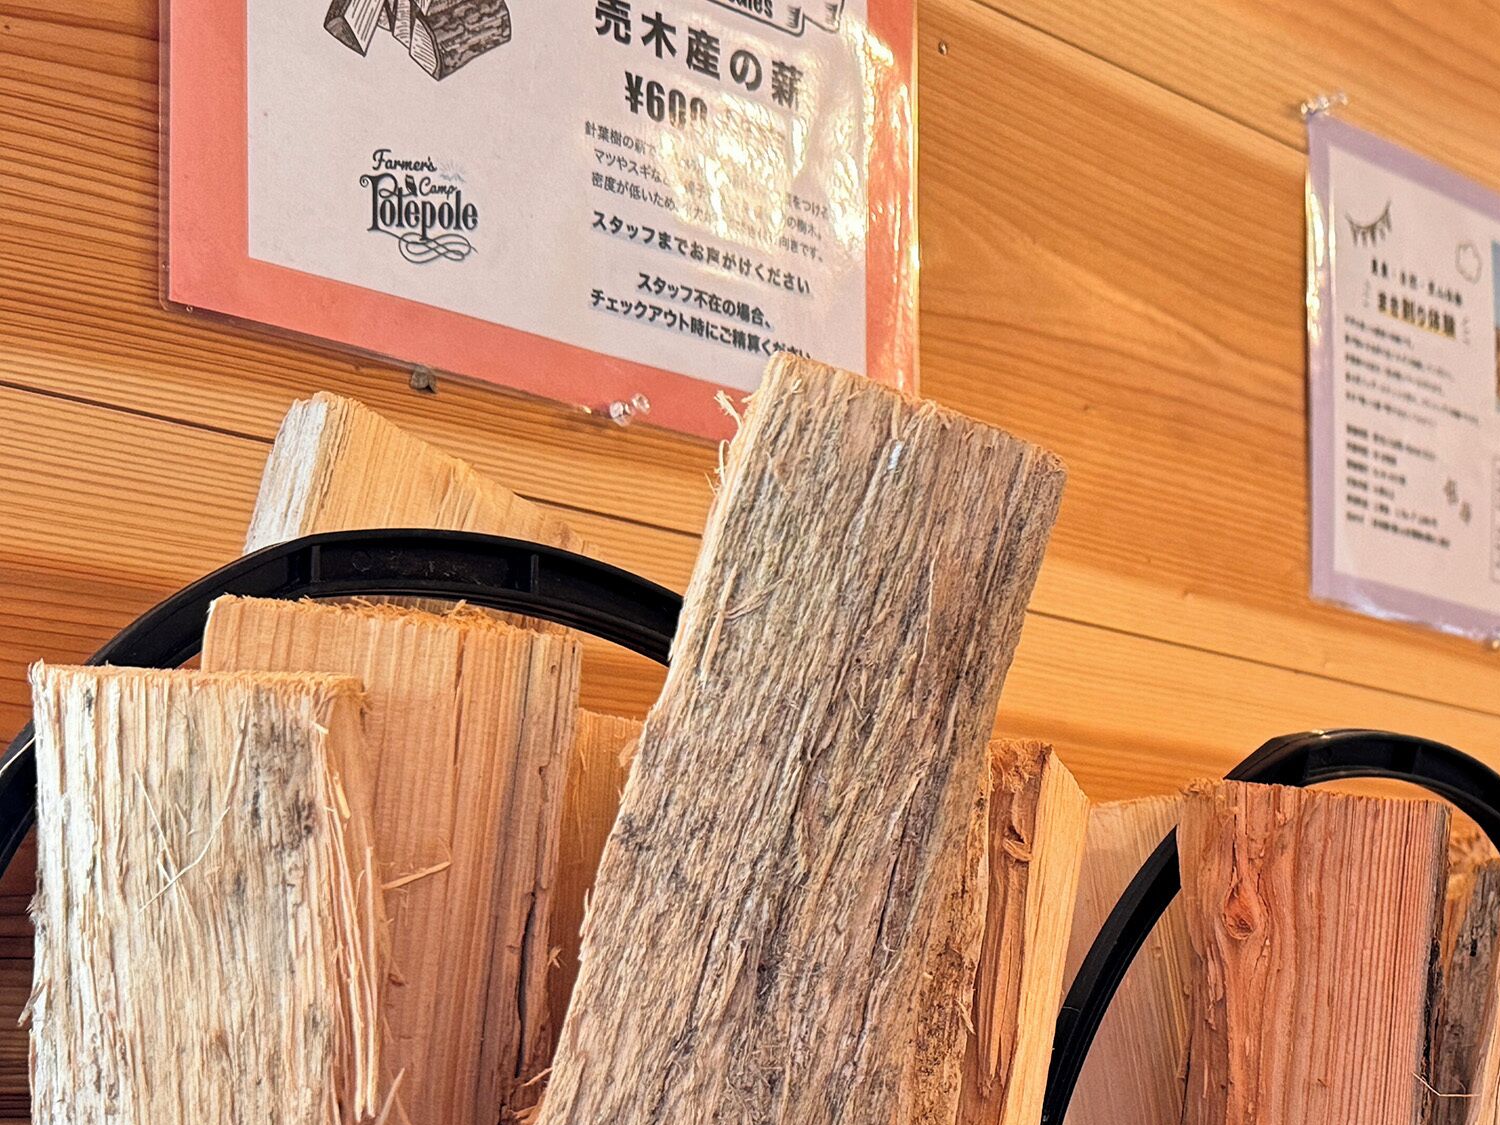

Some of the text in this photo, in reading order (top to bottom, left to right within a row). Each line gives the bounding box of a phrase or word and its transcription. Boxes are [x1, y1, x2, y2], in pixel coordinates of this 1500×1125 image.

[372, 148, 437, 172] Farmer's
[419, 176, 458, 201] Camp
[592, 210, 812, 295] スタッフまでお声がけください
